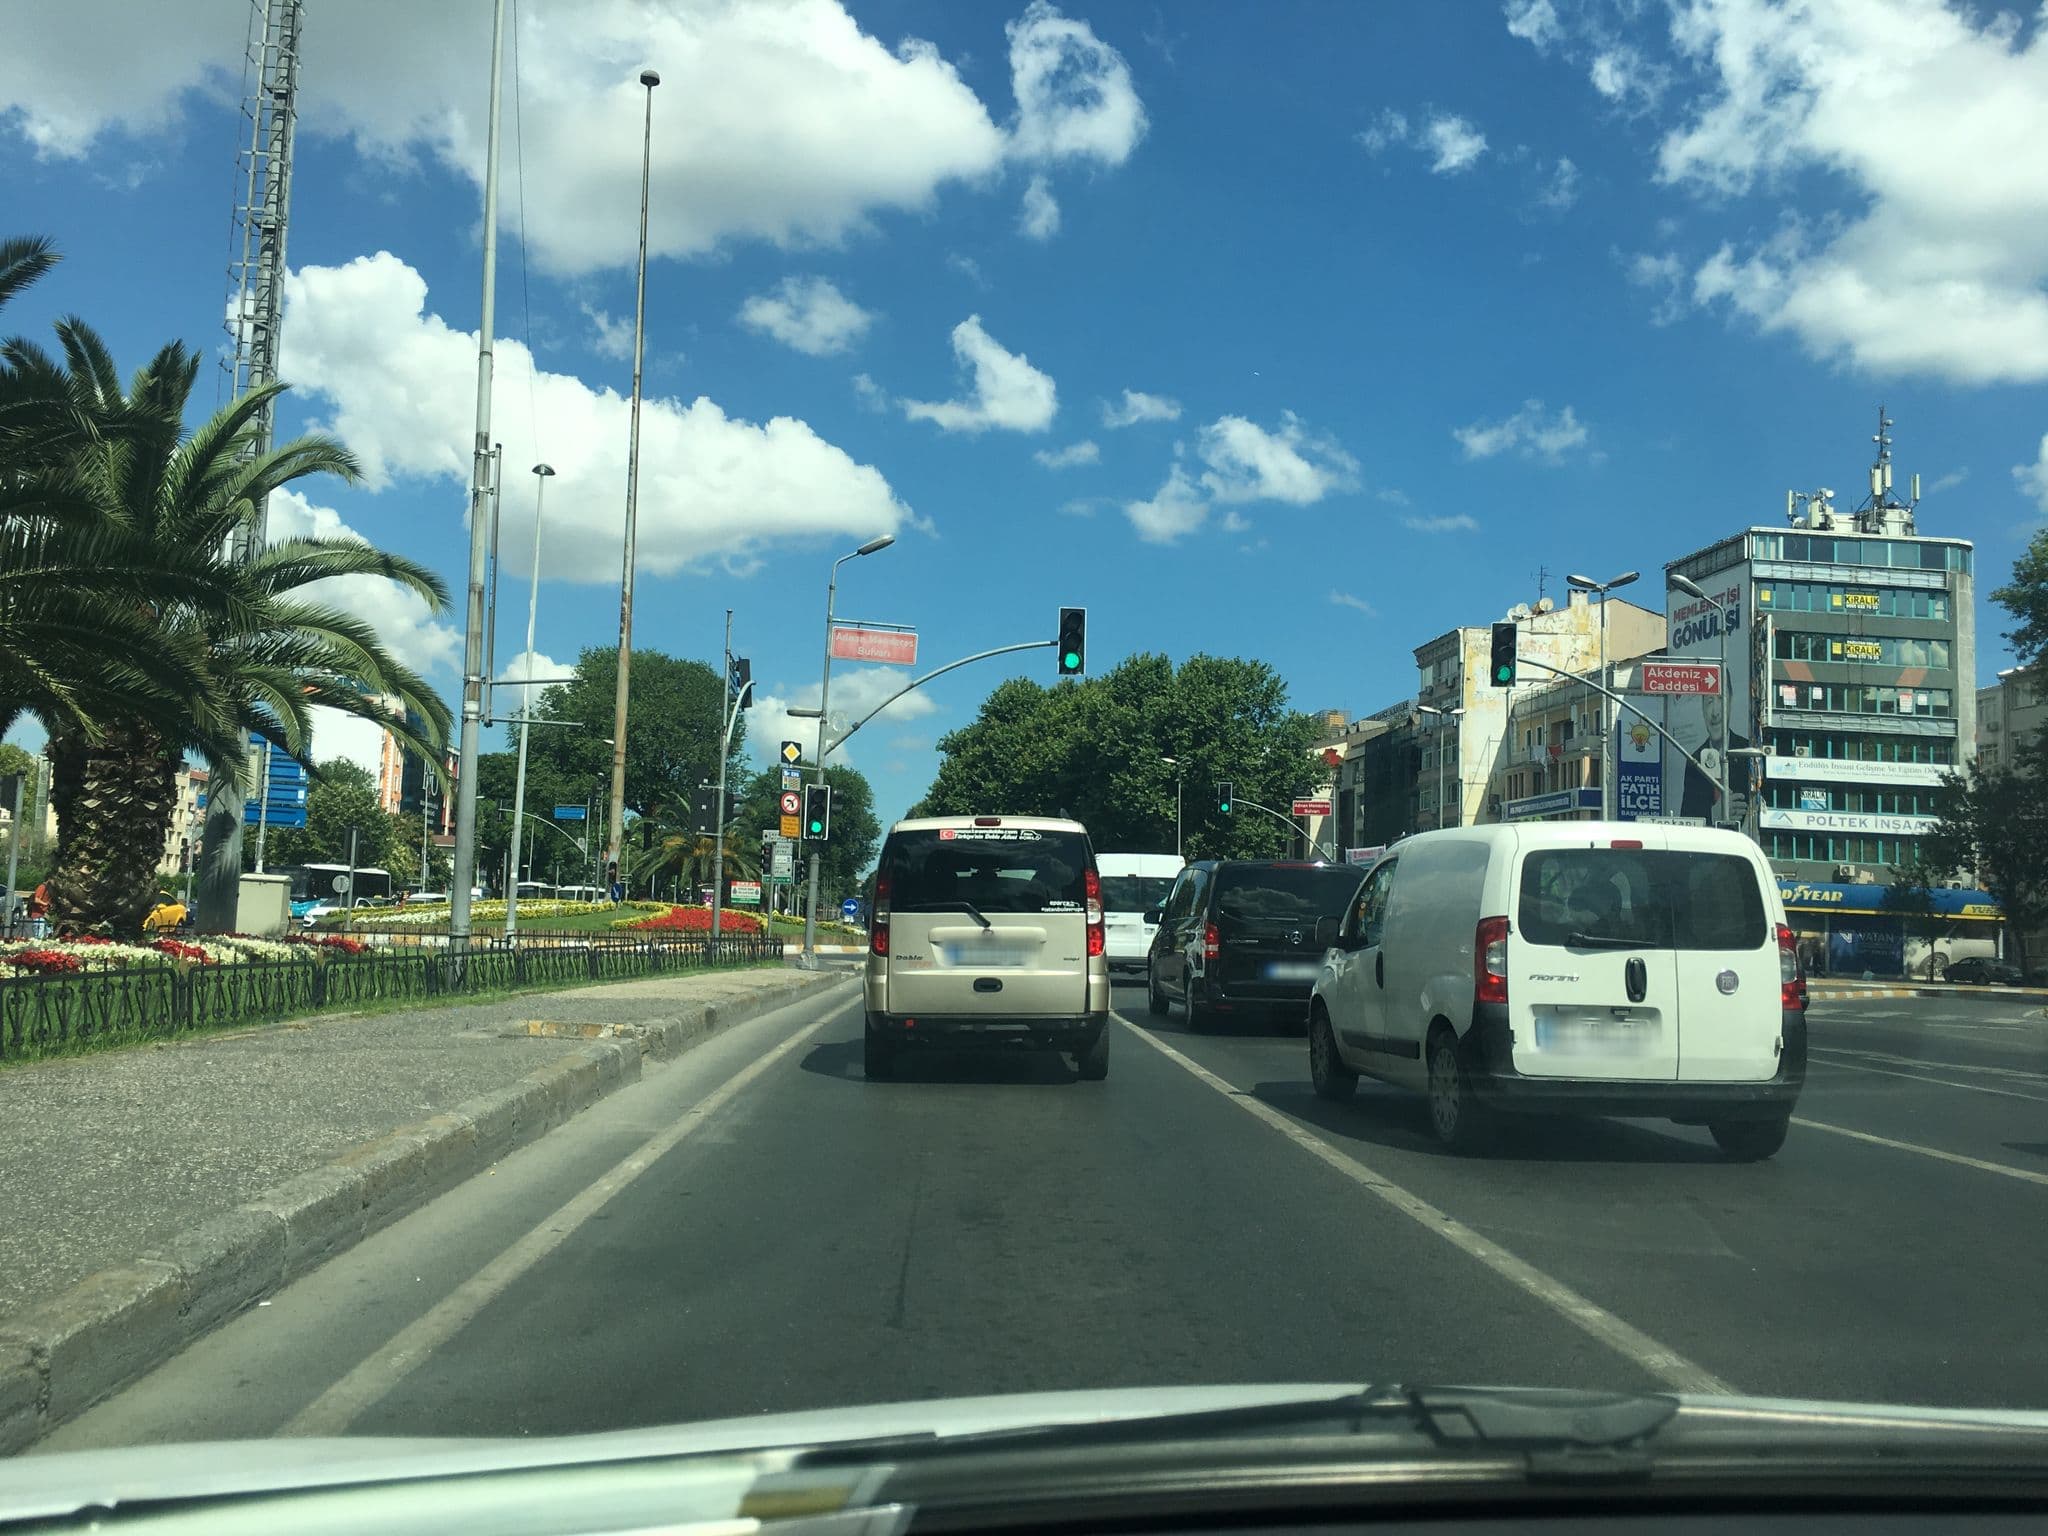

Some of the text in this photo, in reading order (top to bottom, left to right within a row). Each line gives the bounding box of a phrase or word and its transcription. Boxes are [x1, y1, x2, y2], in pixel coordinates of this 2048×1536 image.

[1672, 612, 1721, 650] GÖNÜL
[1647, 667, 1701, 679] Akdeniz
[1649, 680, 1700, 692] Caddesi
[1806, 815, 1868, 828] POLTEK
